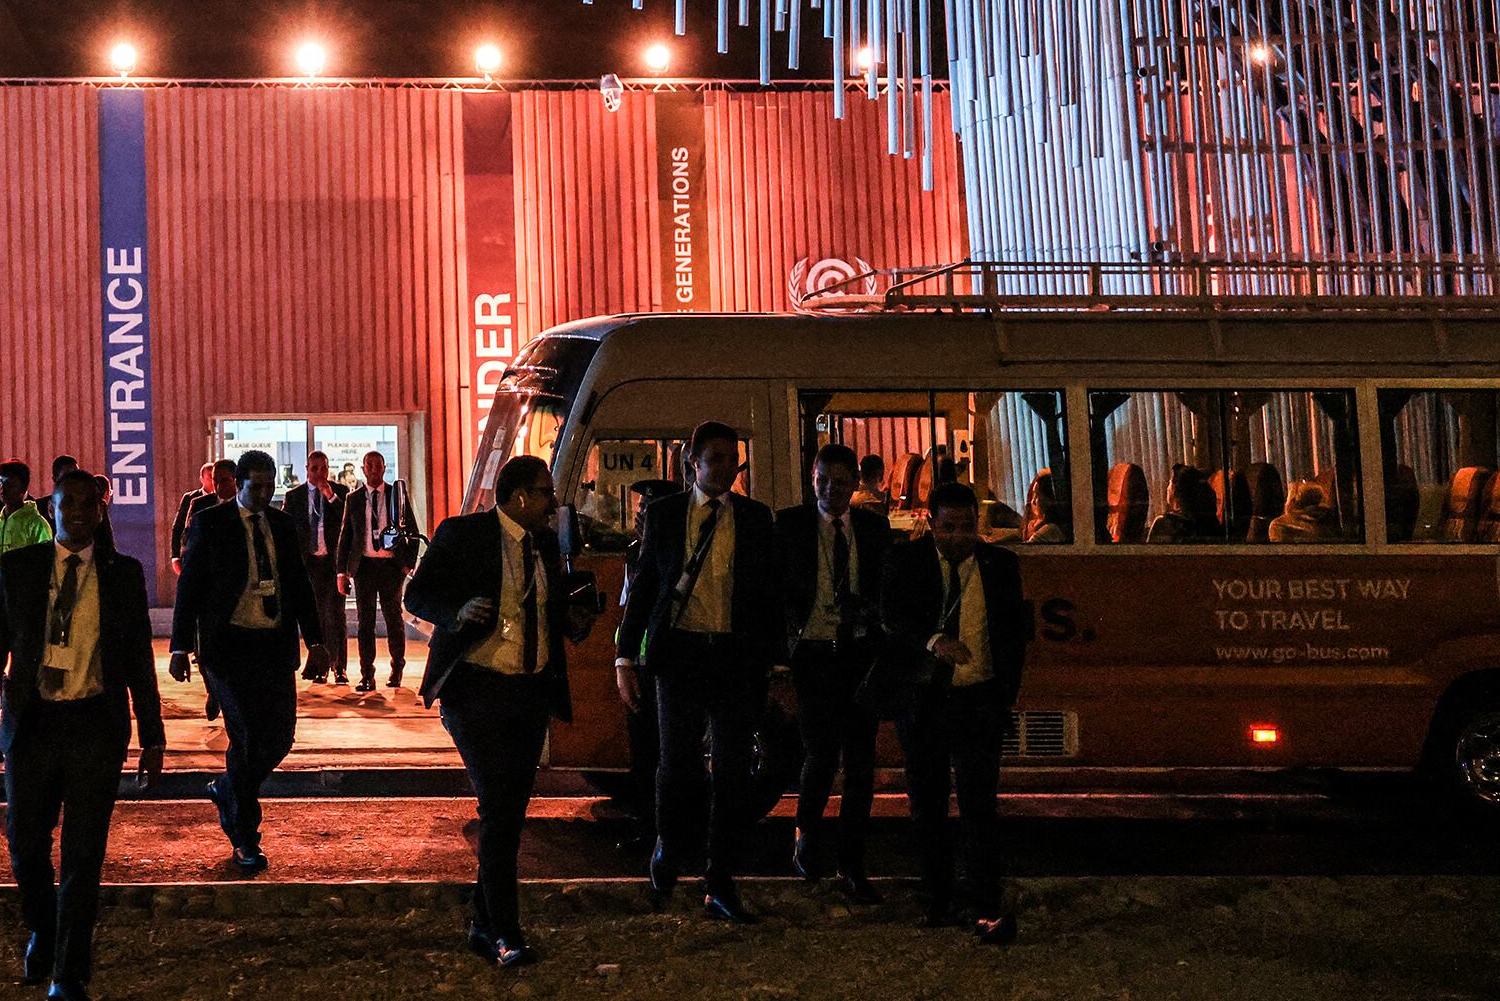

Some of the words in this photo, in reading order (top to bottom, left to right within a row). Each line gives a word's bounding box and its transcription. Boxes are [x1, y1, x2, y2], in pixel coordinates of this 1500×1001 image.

[672, 146, 694, 303] GENERATIONS
[106, 246, 148, 505] ENTRANCE
[603, 453, 634, 471] UN
[641, 454, 654, 471] 4
[1212, 579, 1282, 600] YOUR
[1288, 579, 1350, 600] BEST
[1357, 579, 1410, 600] WAY
[1216, 610, 1249, 630] TO
[1254, 610, 1350, 630] TRAVEL
